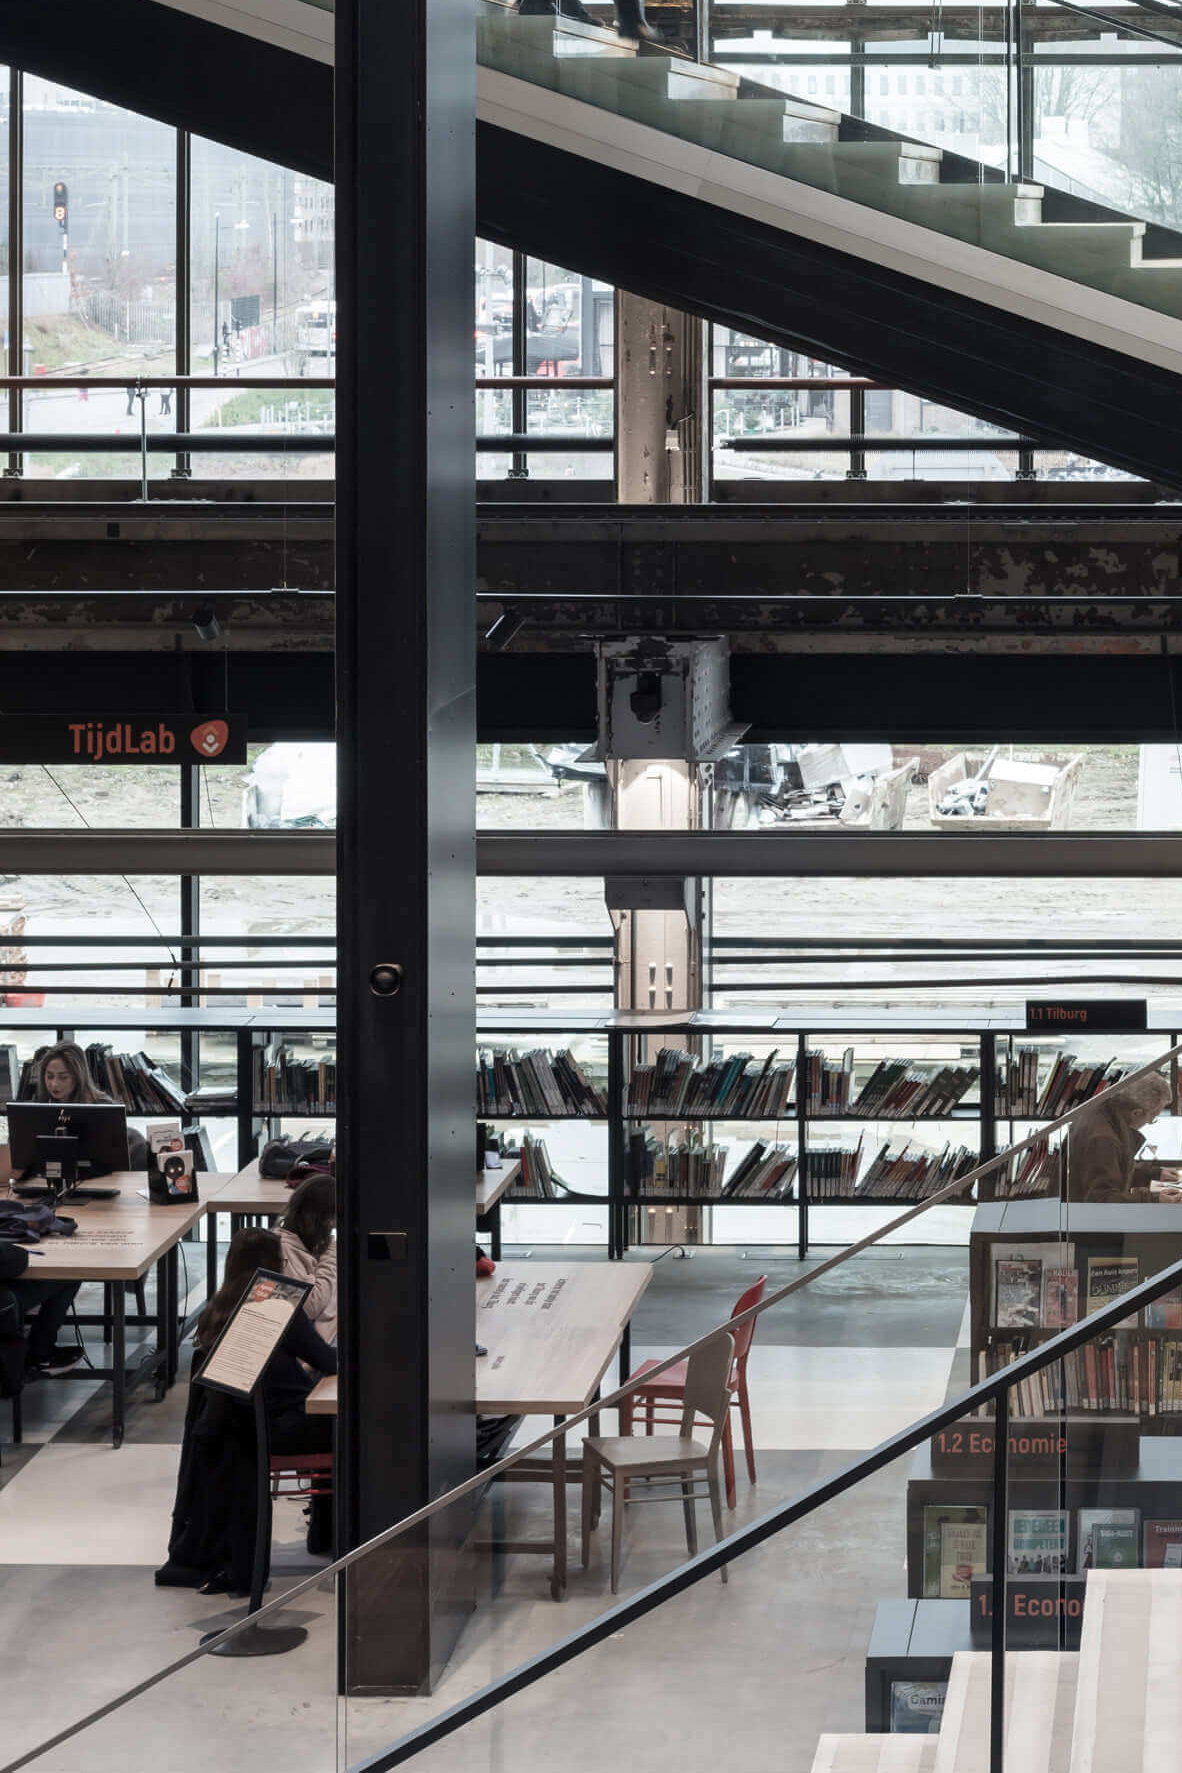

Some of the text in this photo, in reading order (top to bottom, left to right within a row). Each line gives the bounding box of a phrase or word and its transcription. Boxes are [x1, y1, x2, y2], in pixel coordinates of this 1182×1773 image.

[68, 722, 176, 761] TijdLab
[1030, 1007, 1088, 1022] 1.1 Tilburg
[938, 1433, 1068, 1454] 1.2 Ecnomie
[1014, 1594, 1084, 1617] Econo
